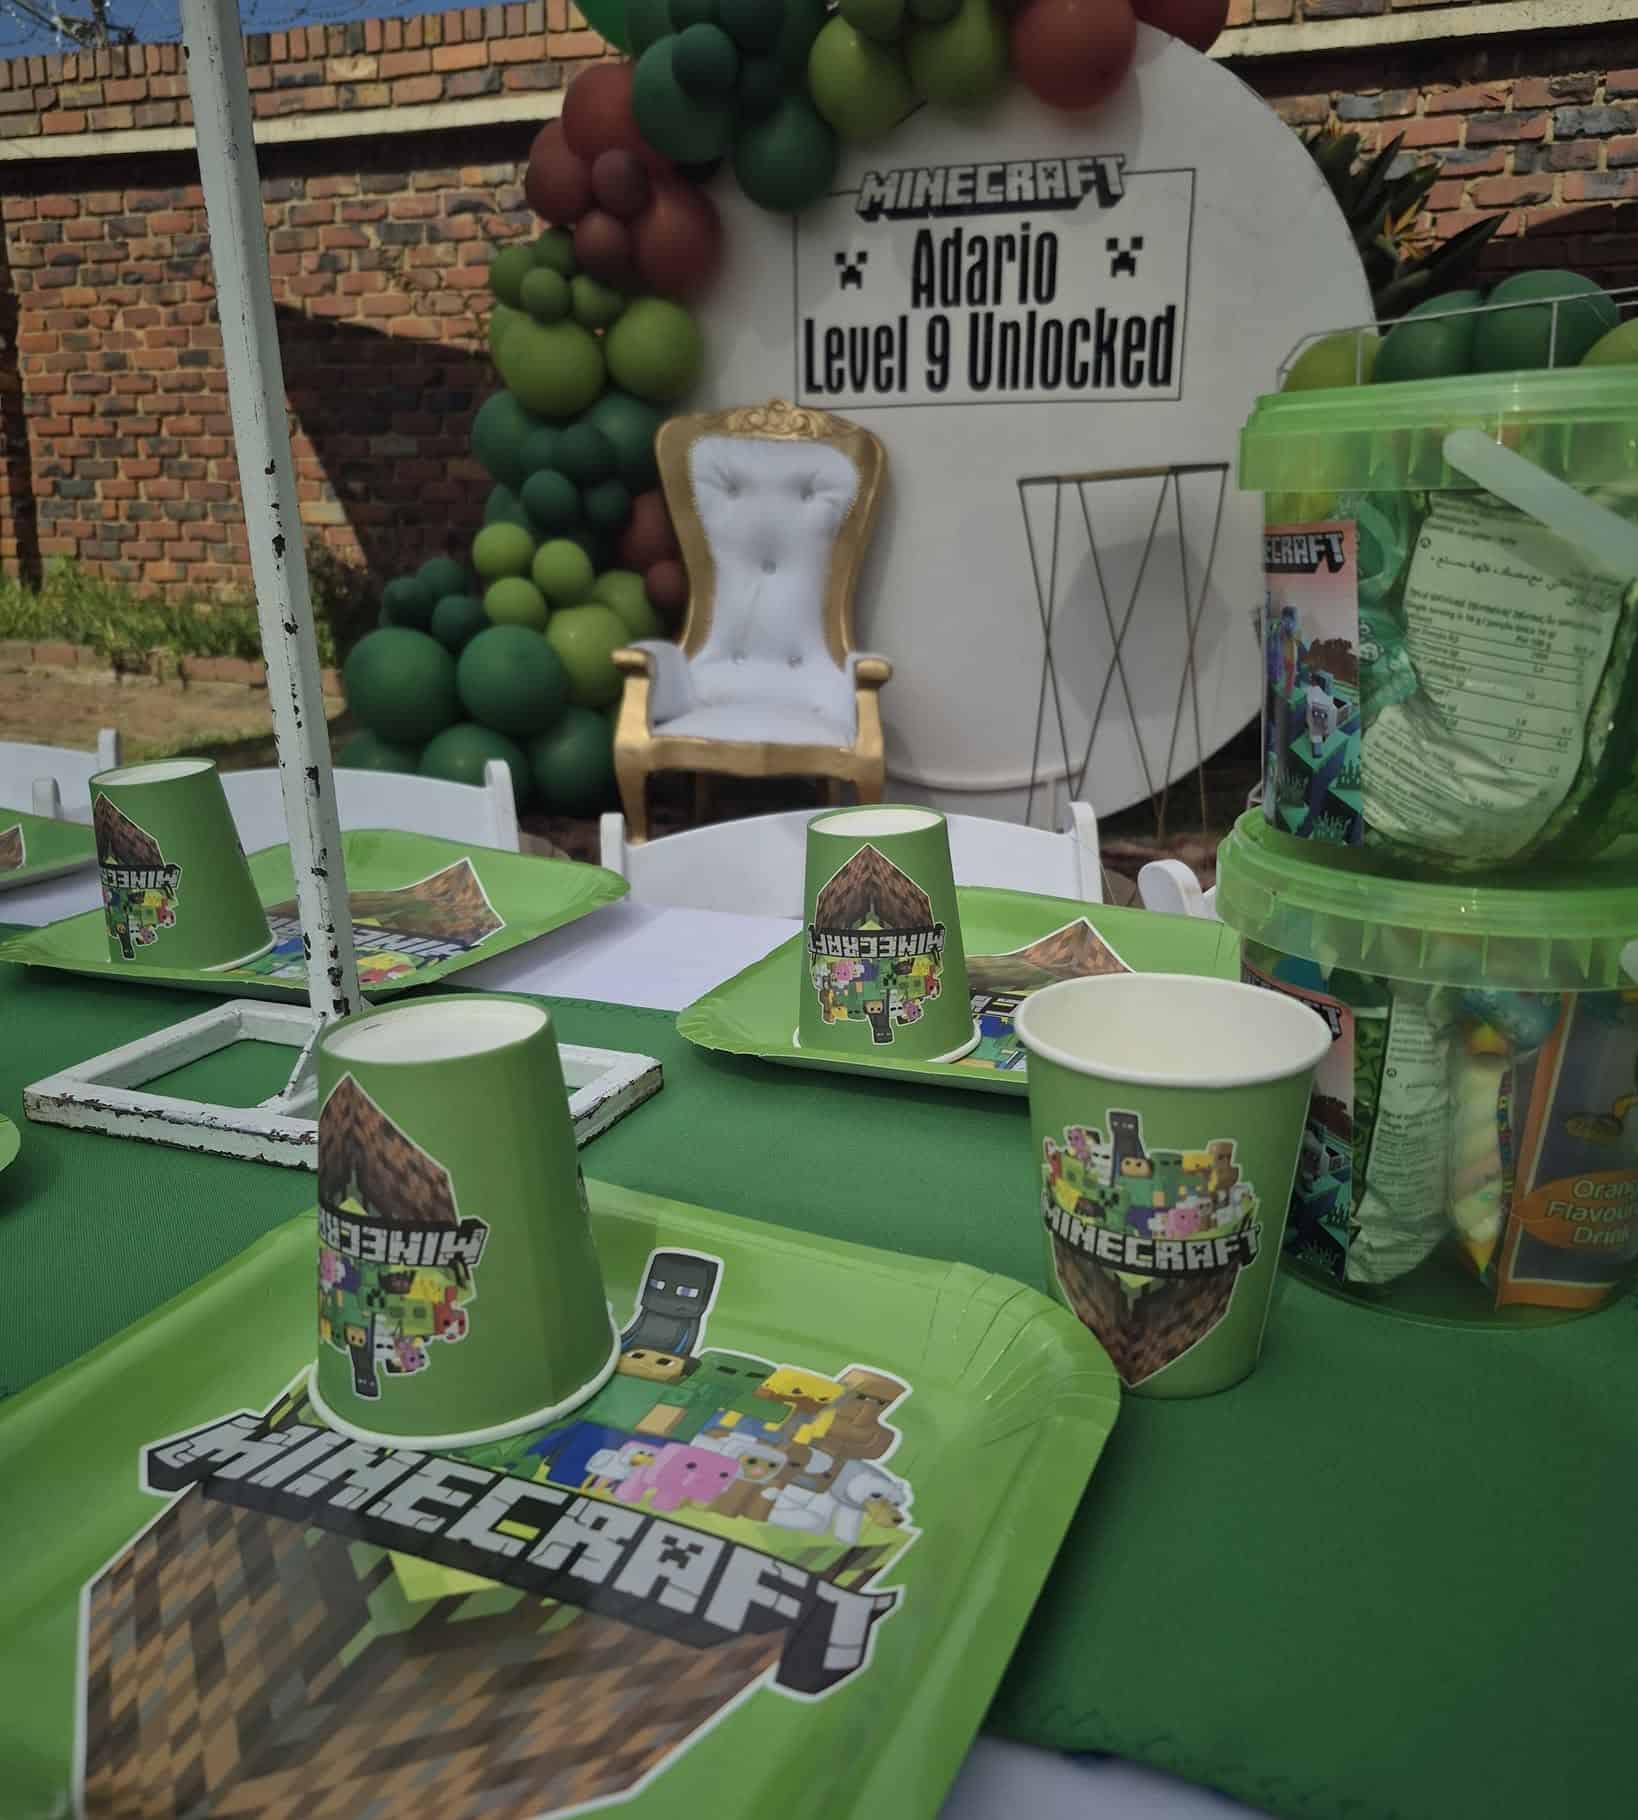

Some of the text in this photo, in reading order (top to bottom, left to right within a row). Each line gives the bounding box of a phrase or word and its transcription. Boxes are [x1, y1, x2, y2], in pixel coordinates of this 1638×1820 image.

[855, 154, 1126, 222] MINECRAFT
[911, 221, 1058, 309] Adario
[804, 304, 1177, 395] Level 9 Unlocked
[146, 1411, 897, 1695] MINECRAFT
